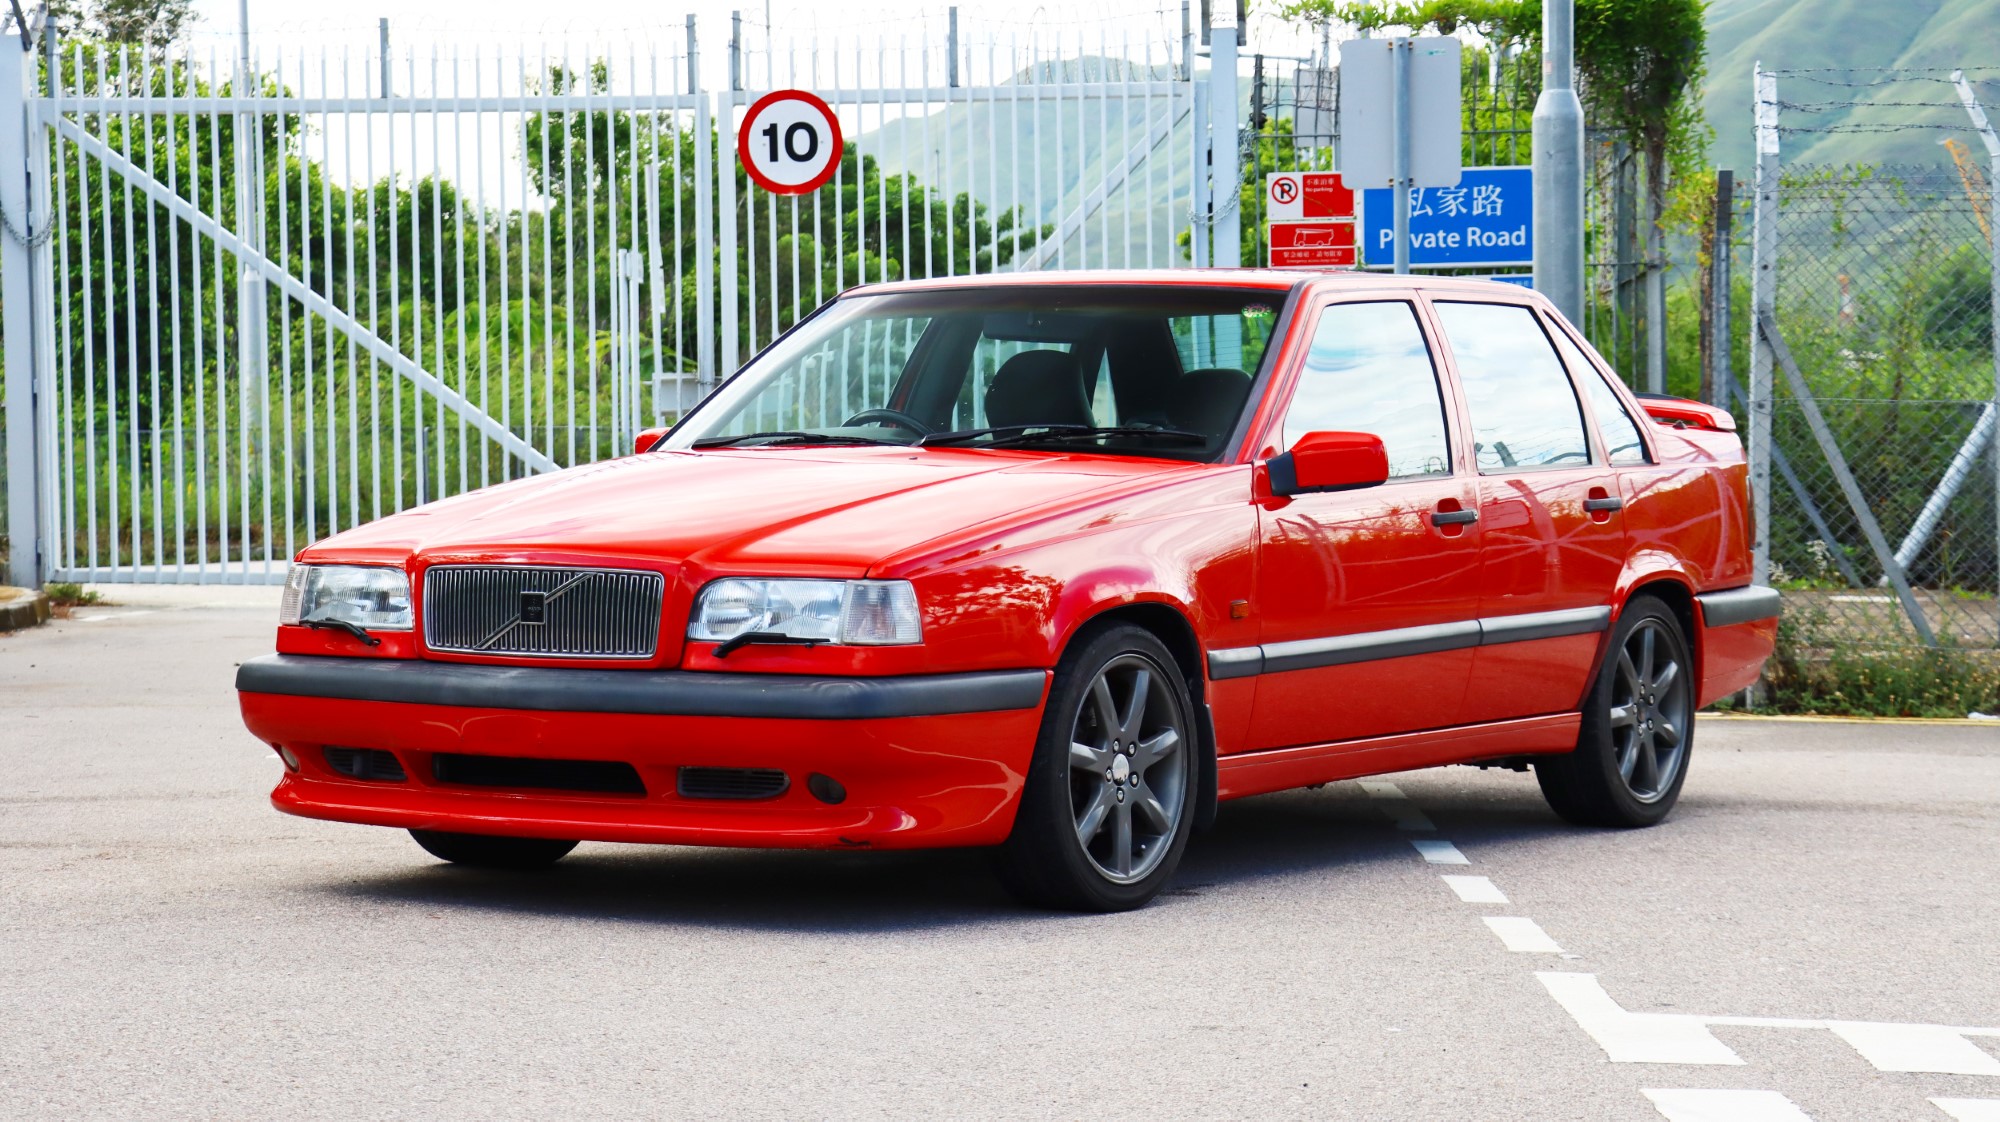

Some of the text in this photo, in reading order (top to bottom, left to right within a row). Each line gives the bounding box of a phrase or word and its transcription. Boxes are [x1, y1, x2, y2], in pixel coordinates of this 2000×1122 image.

[762, 121, 819, 163] 10
[1407, 184, 1505, 219] 私家路
[1379, 224, 1526, 250] Pvate Road
